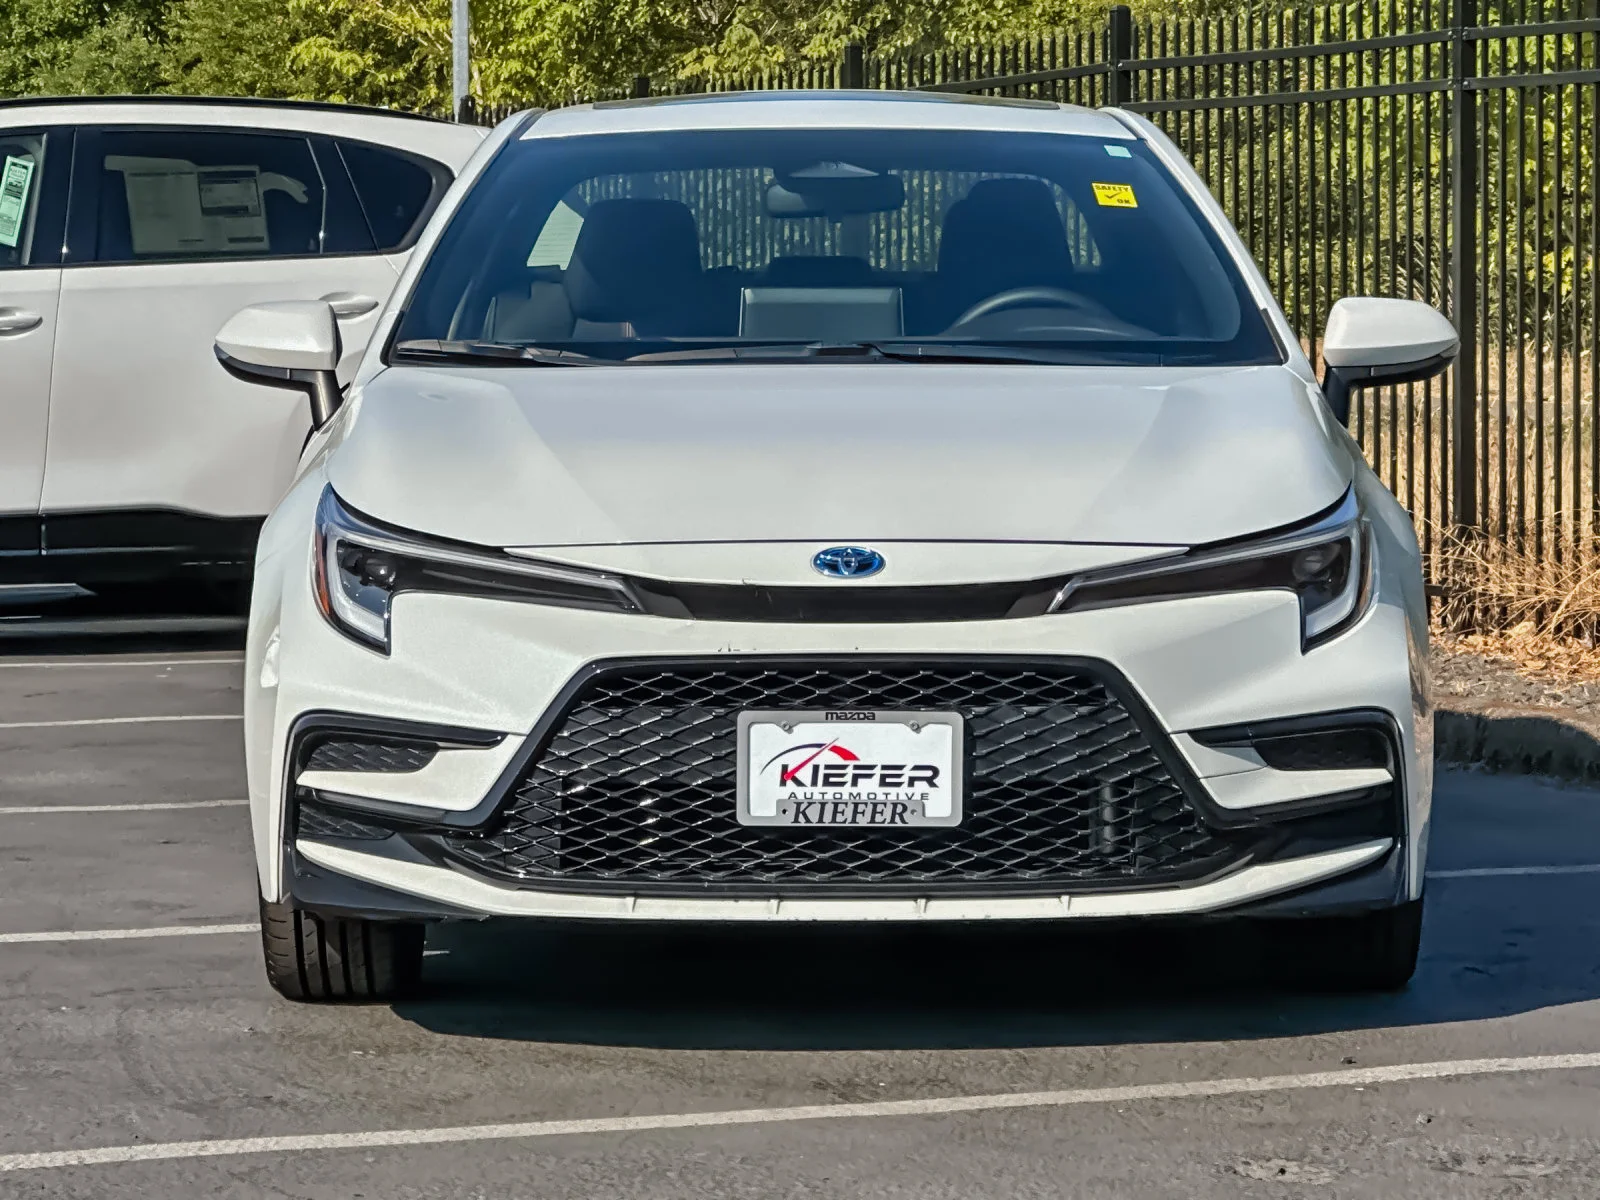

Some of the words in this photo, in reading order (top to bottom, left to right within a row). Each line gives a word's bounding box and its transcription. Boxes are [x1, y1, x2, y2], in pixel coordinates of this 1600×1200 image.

[779, 764, 940, 788] KIEFER
[788, 792, 930, 800] AUTOMOTIVE
[791, 801, 909, 825] KIEFER
